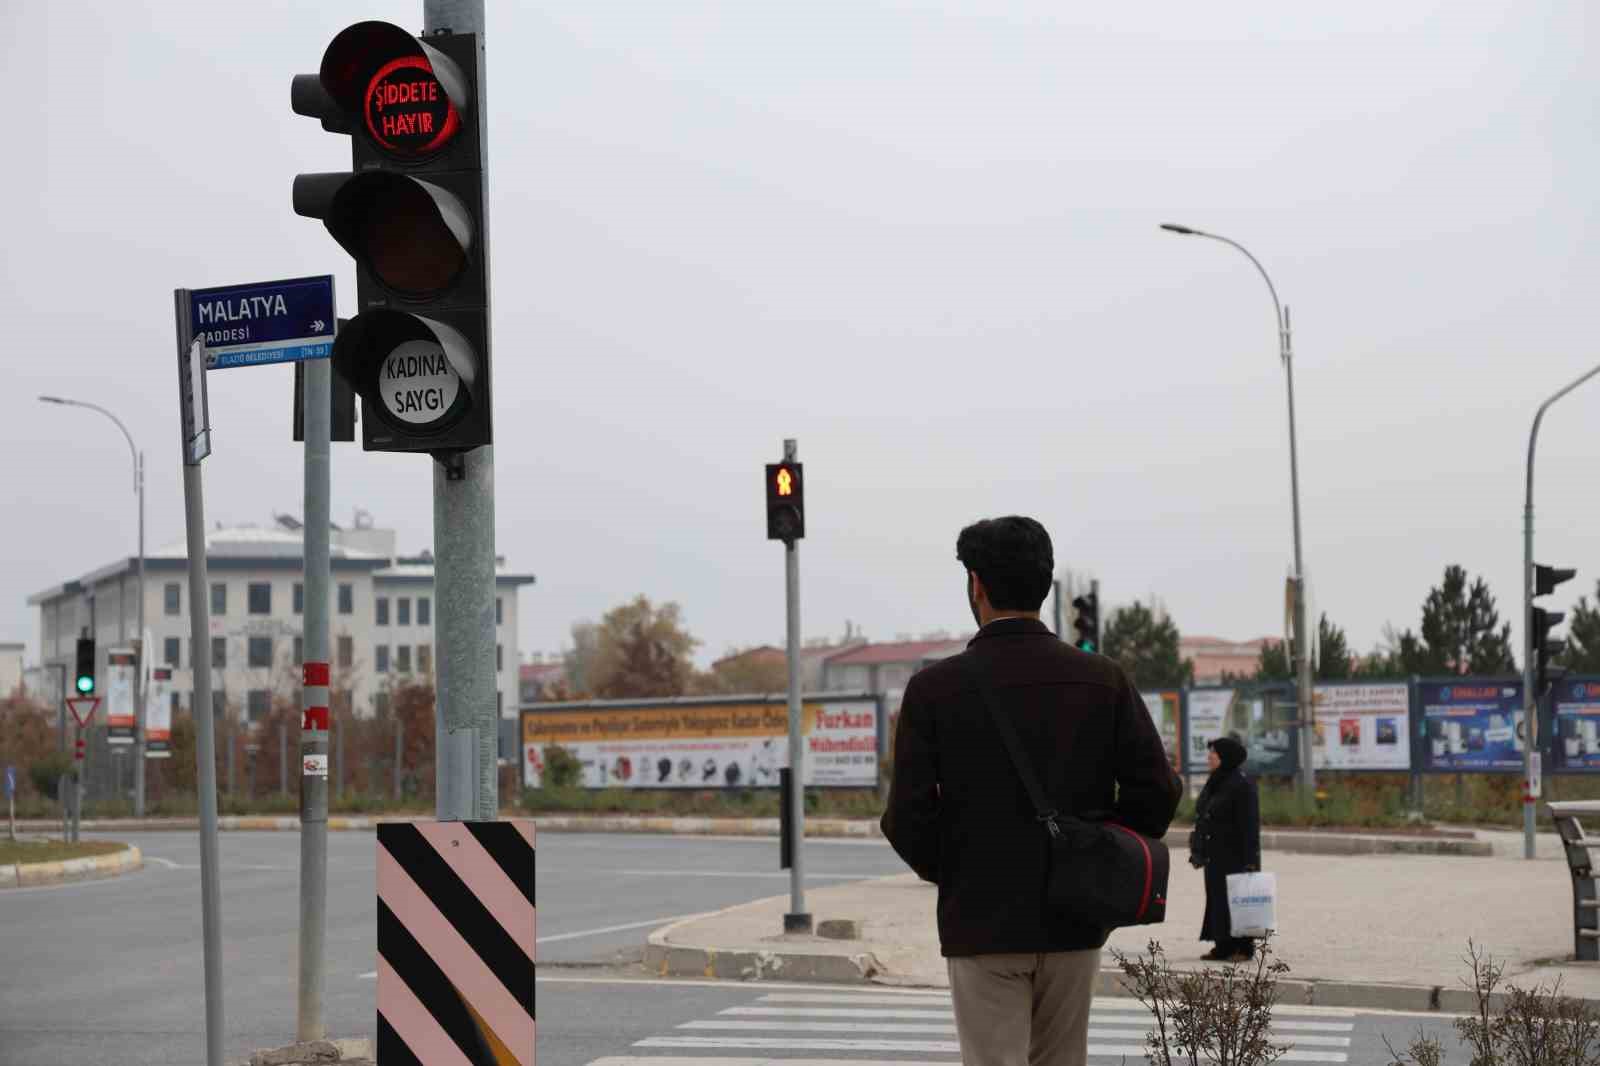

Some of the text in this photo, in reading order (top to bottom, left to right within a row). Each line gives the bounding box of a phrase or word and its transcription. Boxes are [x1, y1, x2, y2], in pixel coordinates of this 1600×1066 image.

[376, 80, 437, 112] ŞİDDETE
[383, 112, 433, 136] HAYIR
[199, 294, 288, 324] MALATYA
[200, 325, 250, 343] ADDESİ
[387, 354, 448, 379] KADINA
[395, 388, 444, 414] SAYGI
